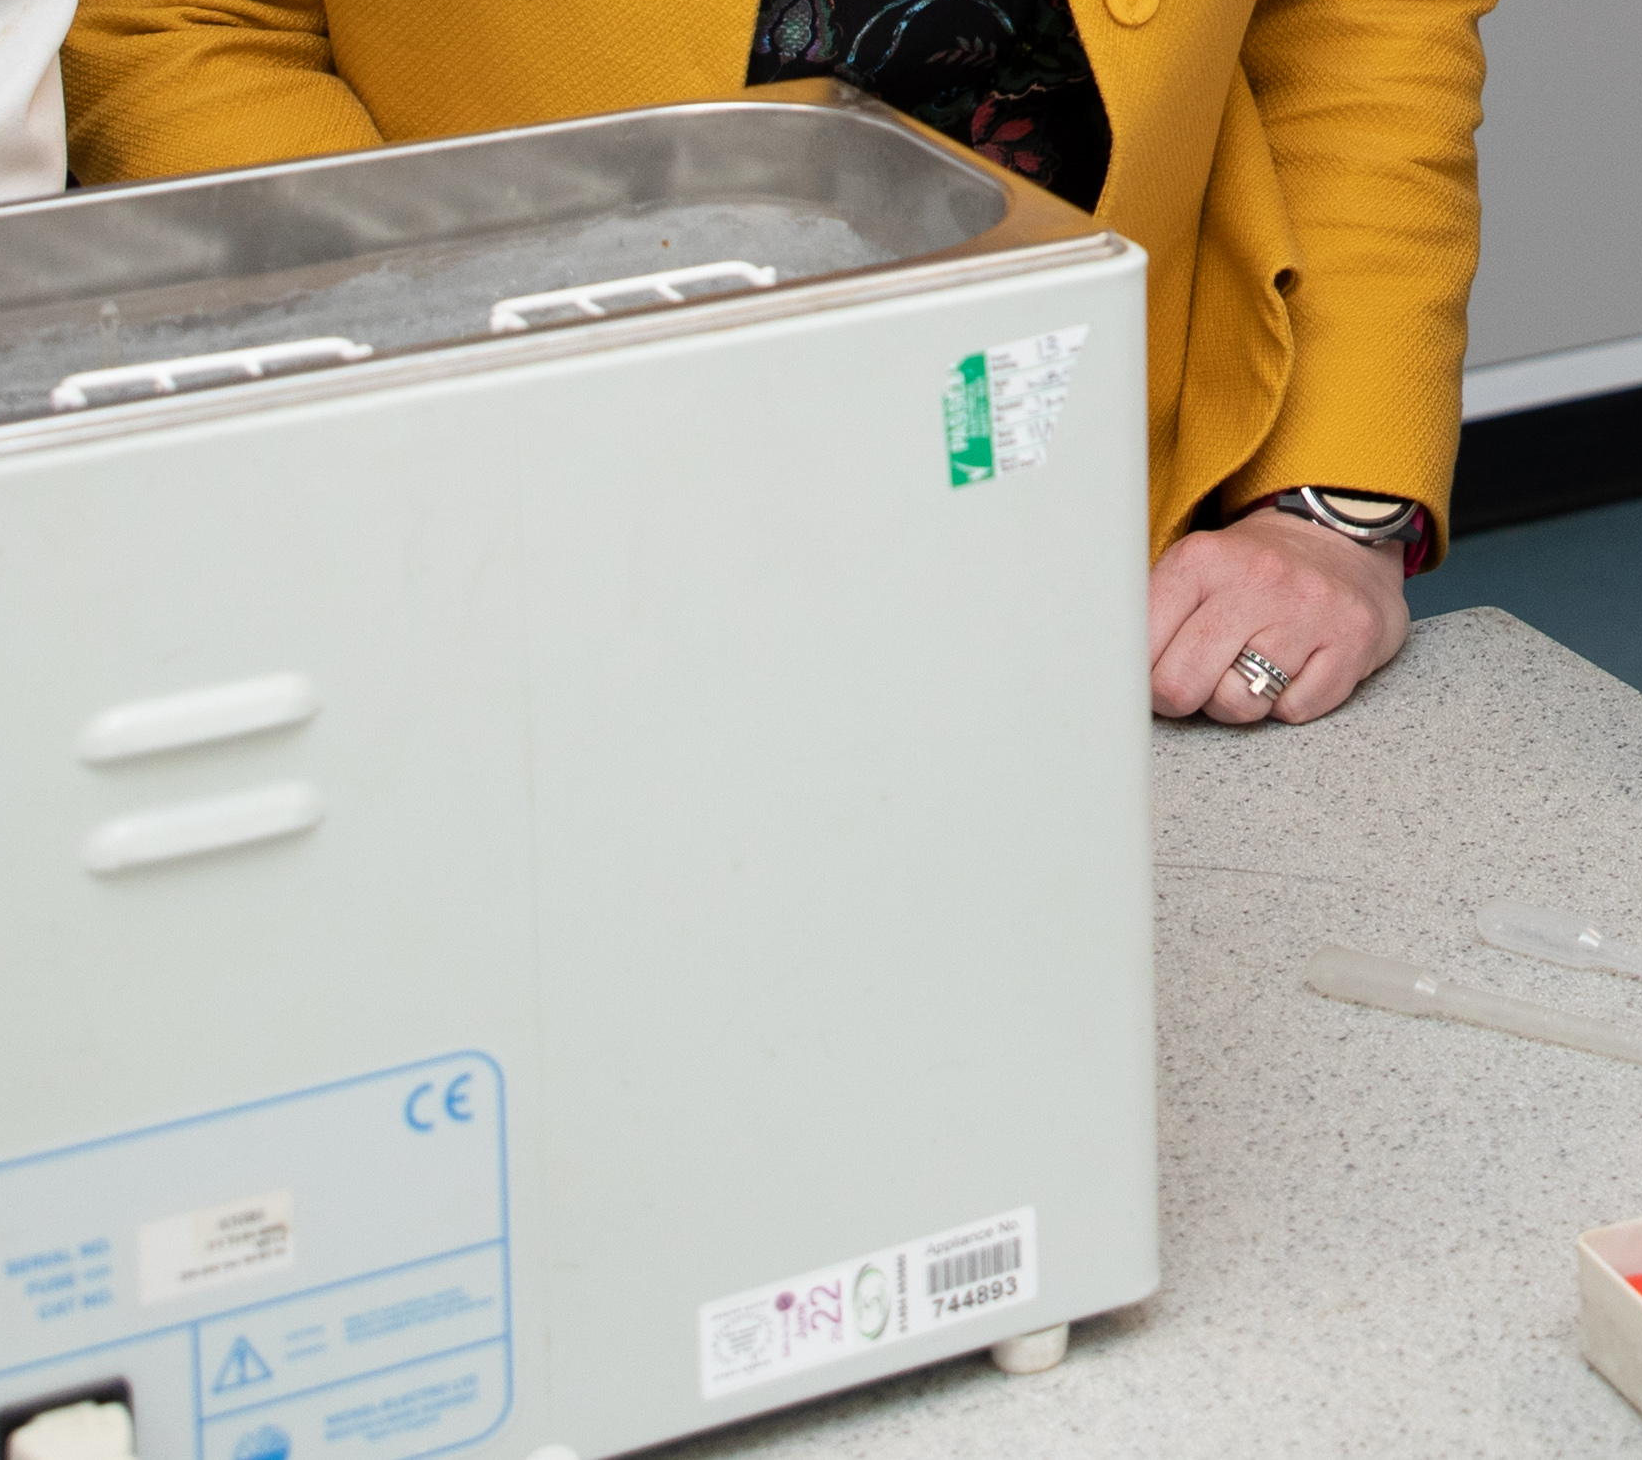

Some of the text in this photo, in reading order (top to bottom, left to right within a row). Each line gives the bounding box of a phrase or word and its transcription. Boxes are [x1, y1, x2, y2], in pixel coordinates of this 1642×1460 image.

[403, 1071, 475, 1133] CE
[926, 1228, 995, 1256] Appliance
[931, 1275, 1019, 1321] 744893
